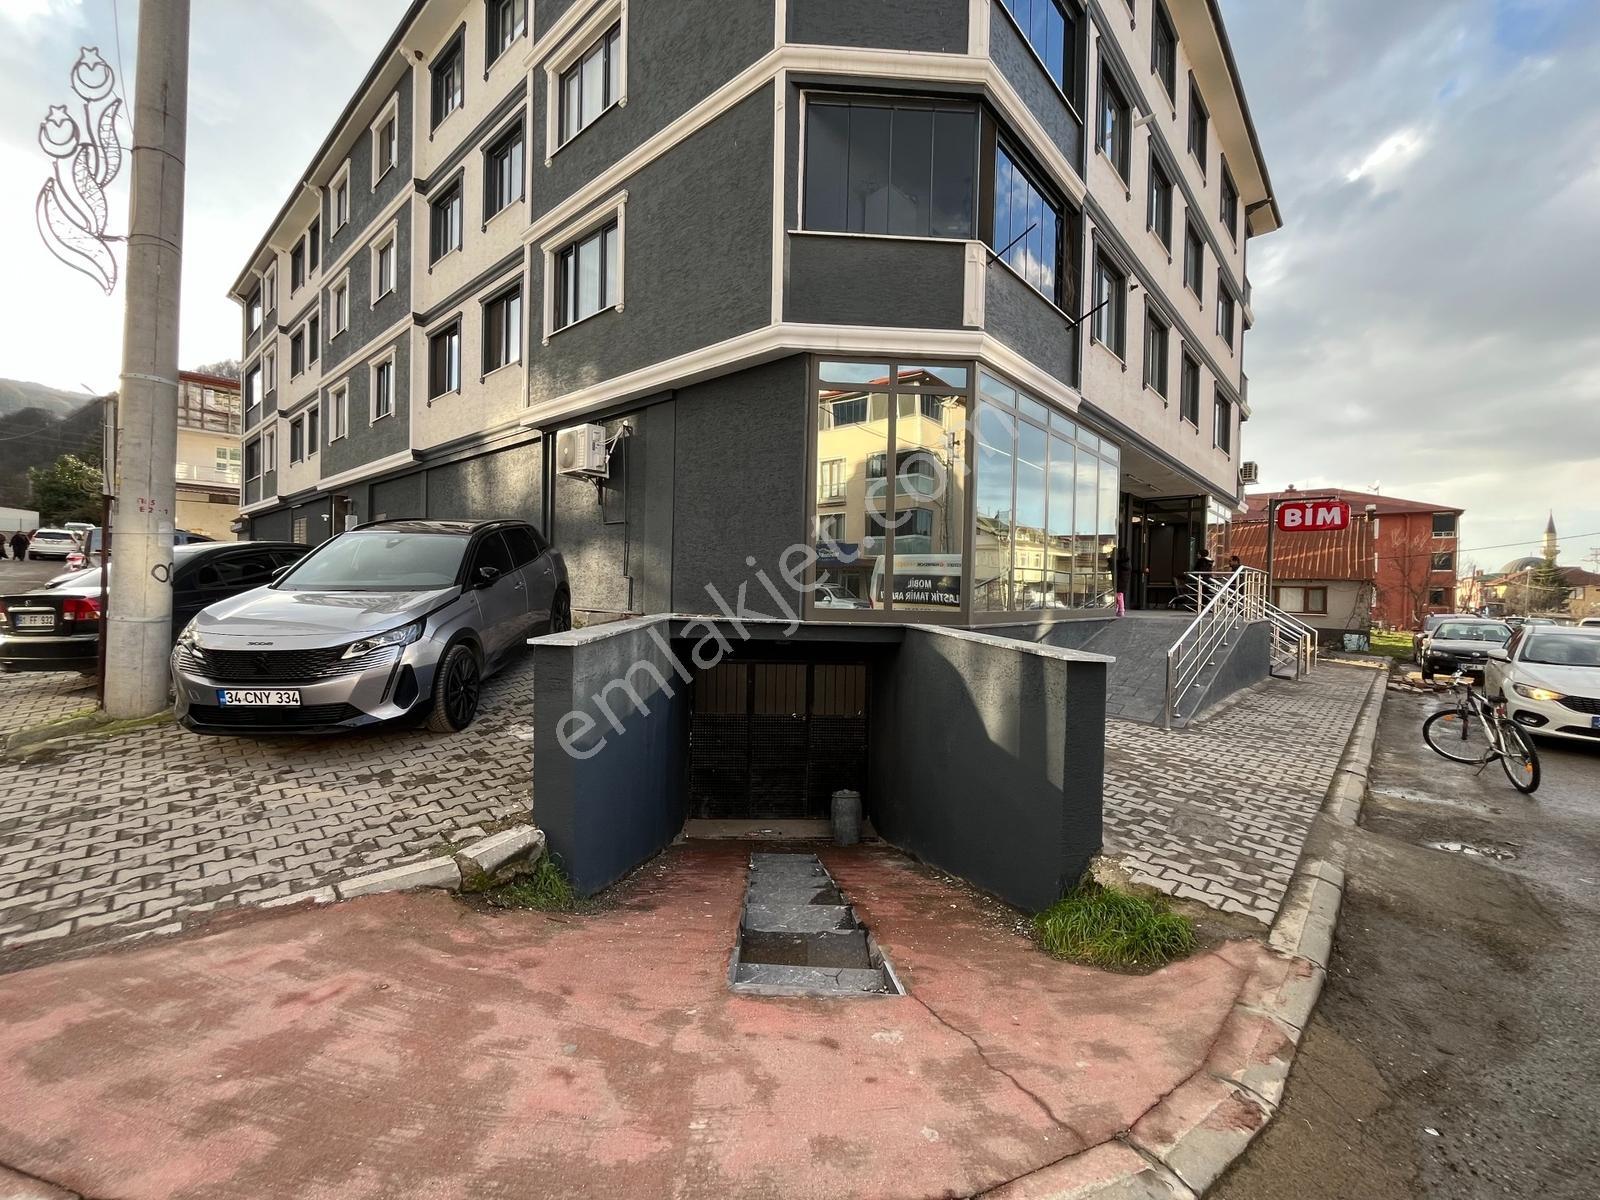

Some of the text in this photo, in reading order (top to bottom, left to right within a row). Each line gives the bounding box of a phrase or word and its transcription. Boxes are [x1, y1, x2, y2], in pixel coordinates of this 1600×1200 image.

[1284, 503, 1342, 527] BİM
[225, 692, 242, 704] 34
[244, 691, 271, 704] CNY
[275, 691, 299, 704] 334
